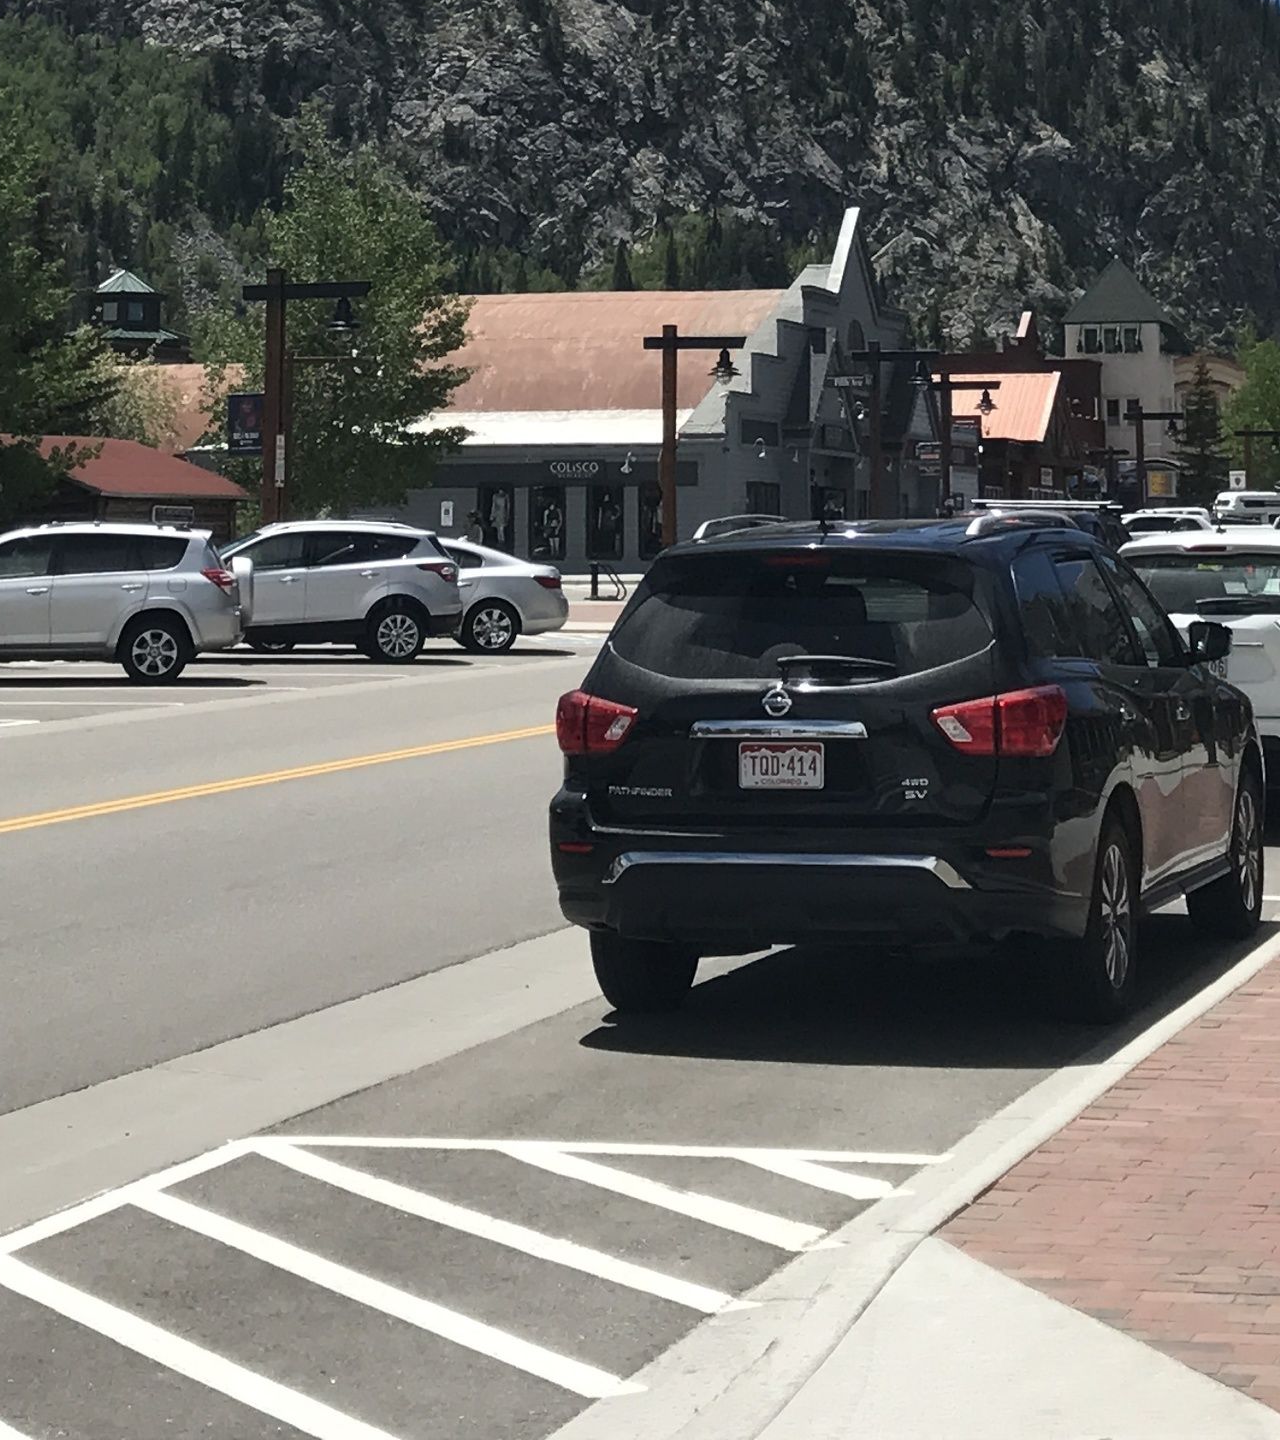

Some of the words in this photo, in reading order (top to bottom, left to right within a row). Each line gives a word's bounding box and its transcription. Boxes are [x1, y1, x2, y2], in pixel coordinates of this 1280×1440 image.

[901, 778, 929, 786] 4WD
[608, 785, 673, 797] PATHFINDER
[905, 789, 928, 799] SV
